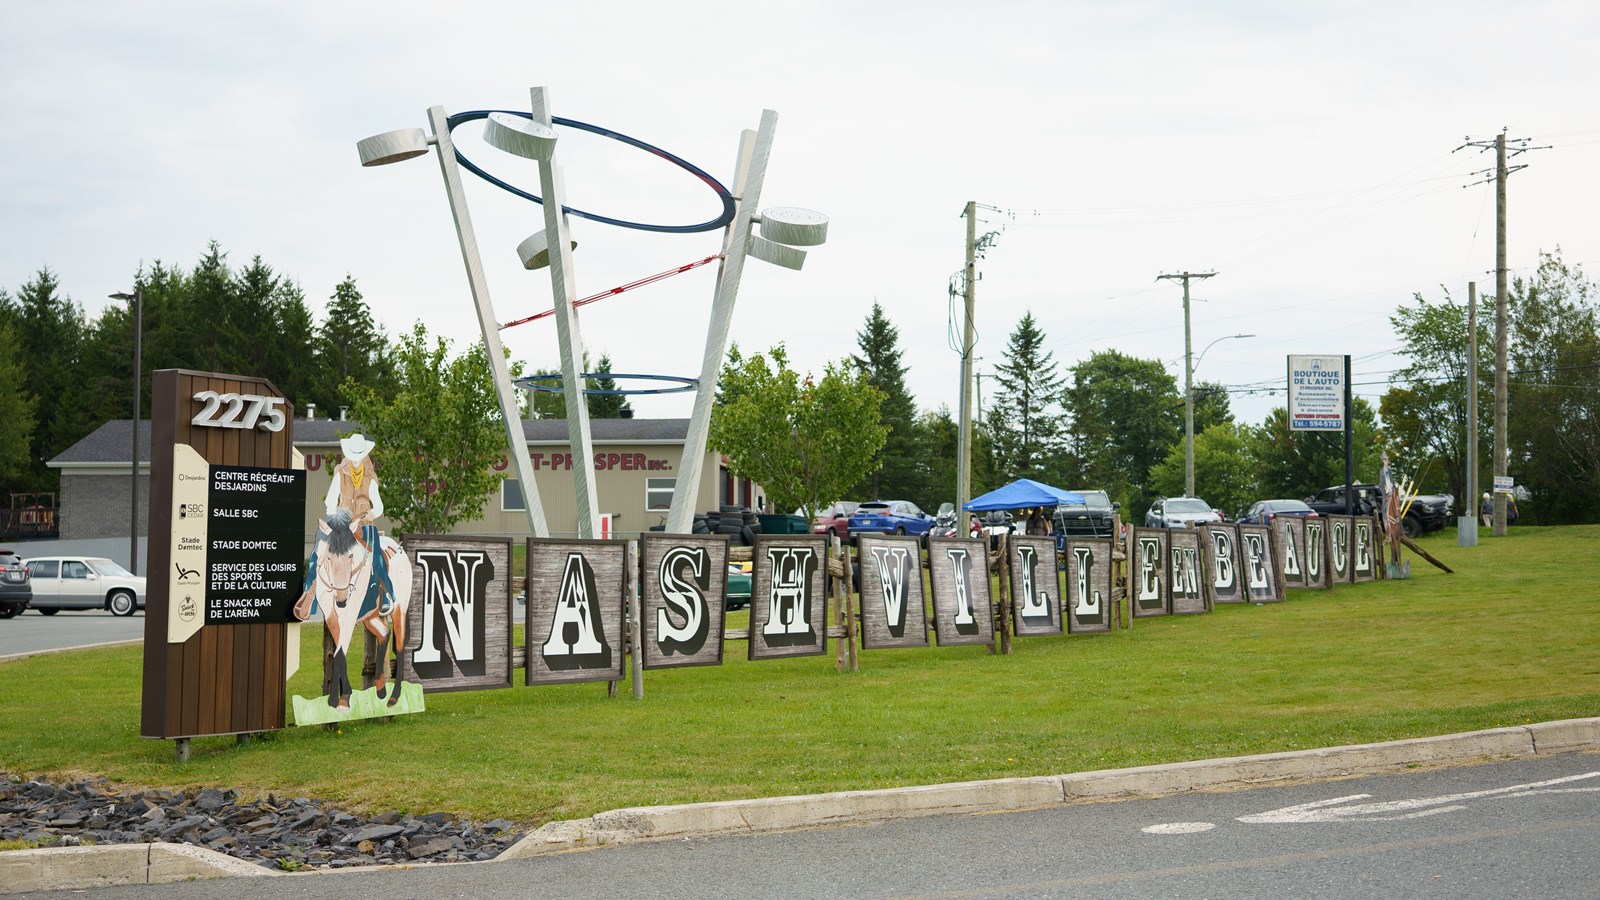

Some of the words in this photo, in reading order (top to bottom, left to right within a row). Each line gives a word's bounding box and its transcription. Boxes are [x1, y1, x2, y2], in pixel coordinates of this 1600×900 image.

[192, 390, 286, 432] 2275
[647, 459, 673, 471] INC.
[215, 471, 249, 481] CENTRE
[250, 472, 295, 483] RÉCRÉATIF
[214, 481, 267, 492] DESJARDINS
[187, 504, 204, 513] SBC
[213, 508, 240, 518] SALLE
[241, 509, 259, 518] SBC
[212, 540, 240, 549] STADE
[242, 541, 277, 550] DOMTEC
[211, 563, 247, 572] SERVICE
[248, 563, 265, 572] DES
[266, 563, 297, 572] LOISIRS
[1171, 546, 1199, 597] EN
[211, 572, 229, 581] DES
[230, 572, 262, 581] SPORTS
[211, 582, 223, 590] ET
[224, 582, 236, 590] DE
[237, 582, 249, 590] LA
[250, 581, 287, 590] CULTURE
[210, 599, 222, 608] LE
[223, 599, 253, 608] SNACK
[254, 598, 272, 607] BAR
[210, 610, 223, 619] DE
[224, 608, 260, 618] L'ARÉNA
